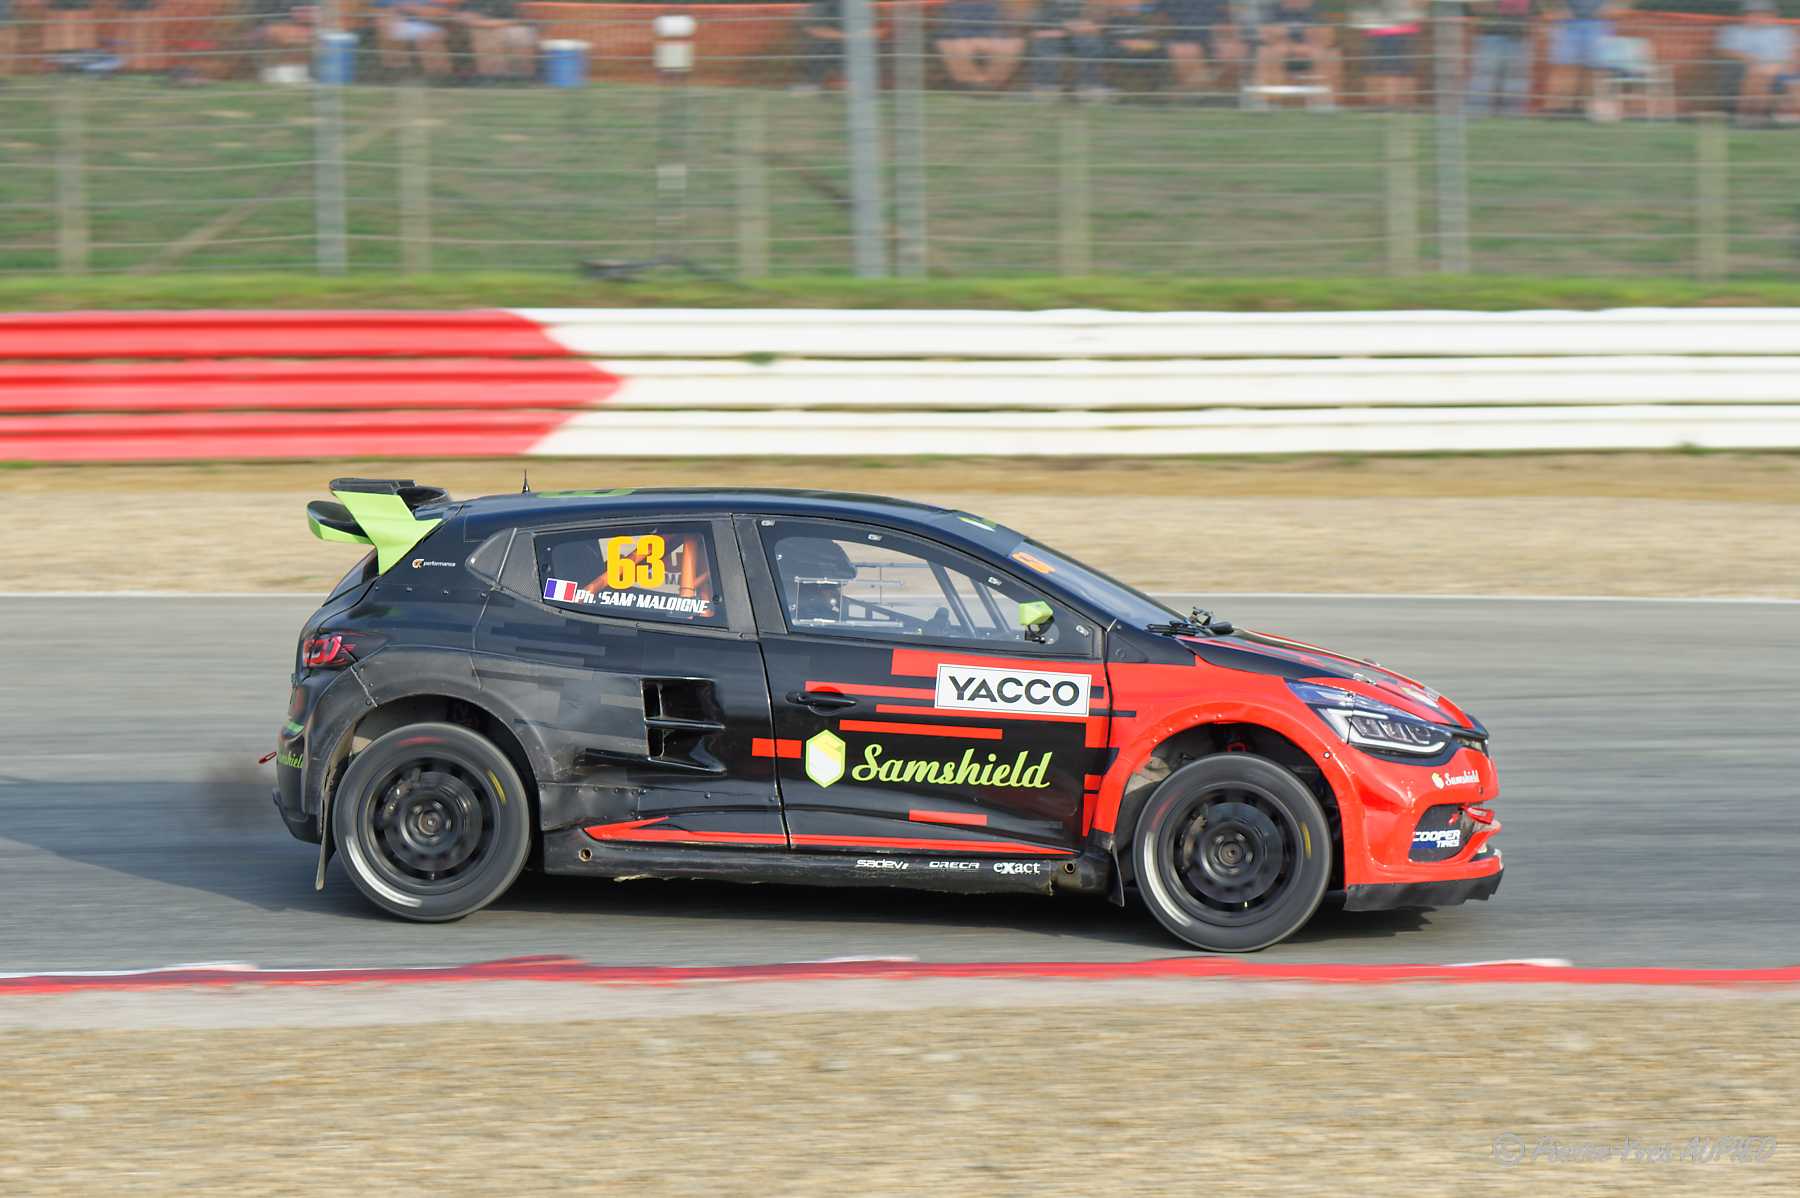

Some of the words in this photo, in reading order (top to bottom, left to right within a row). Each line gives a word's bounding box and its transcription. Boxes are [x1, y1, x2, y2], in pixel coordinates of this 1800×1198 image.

[607, 534, 666, 589] 63
[575, 589, 596, 604] Ph.
[949, 676, 1080, 706] YACCO
[851, 743, 1053, 789] Samshield
